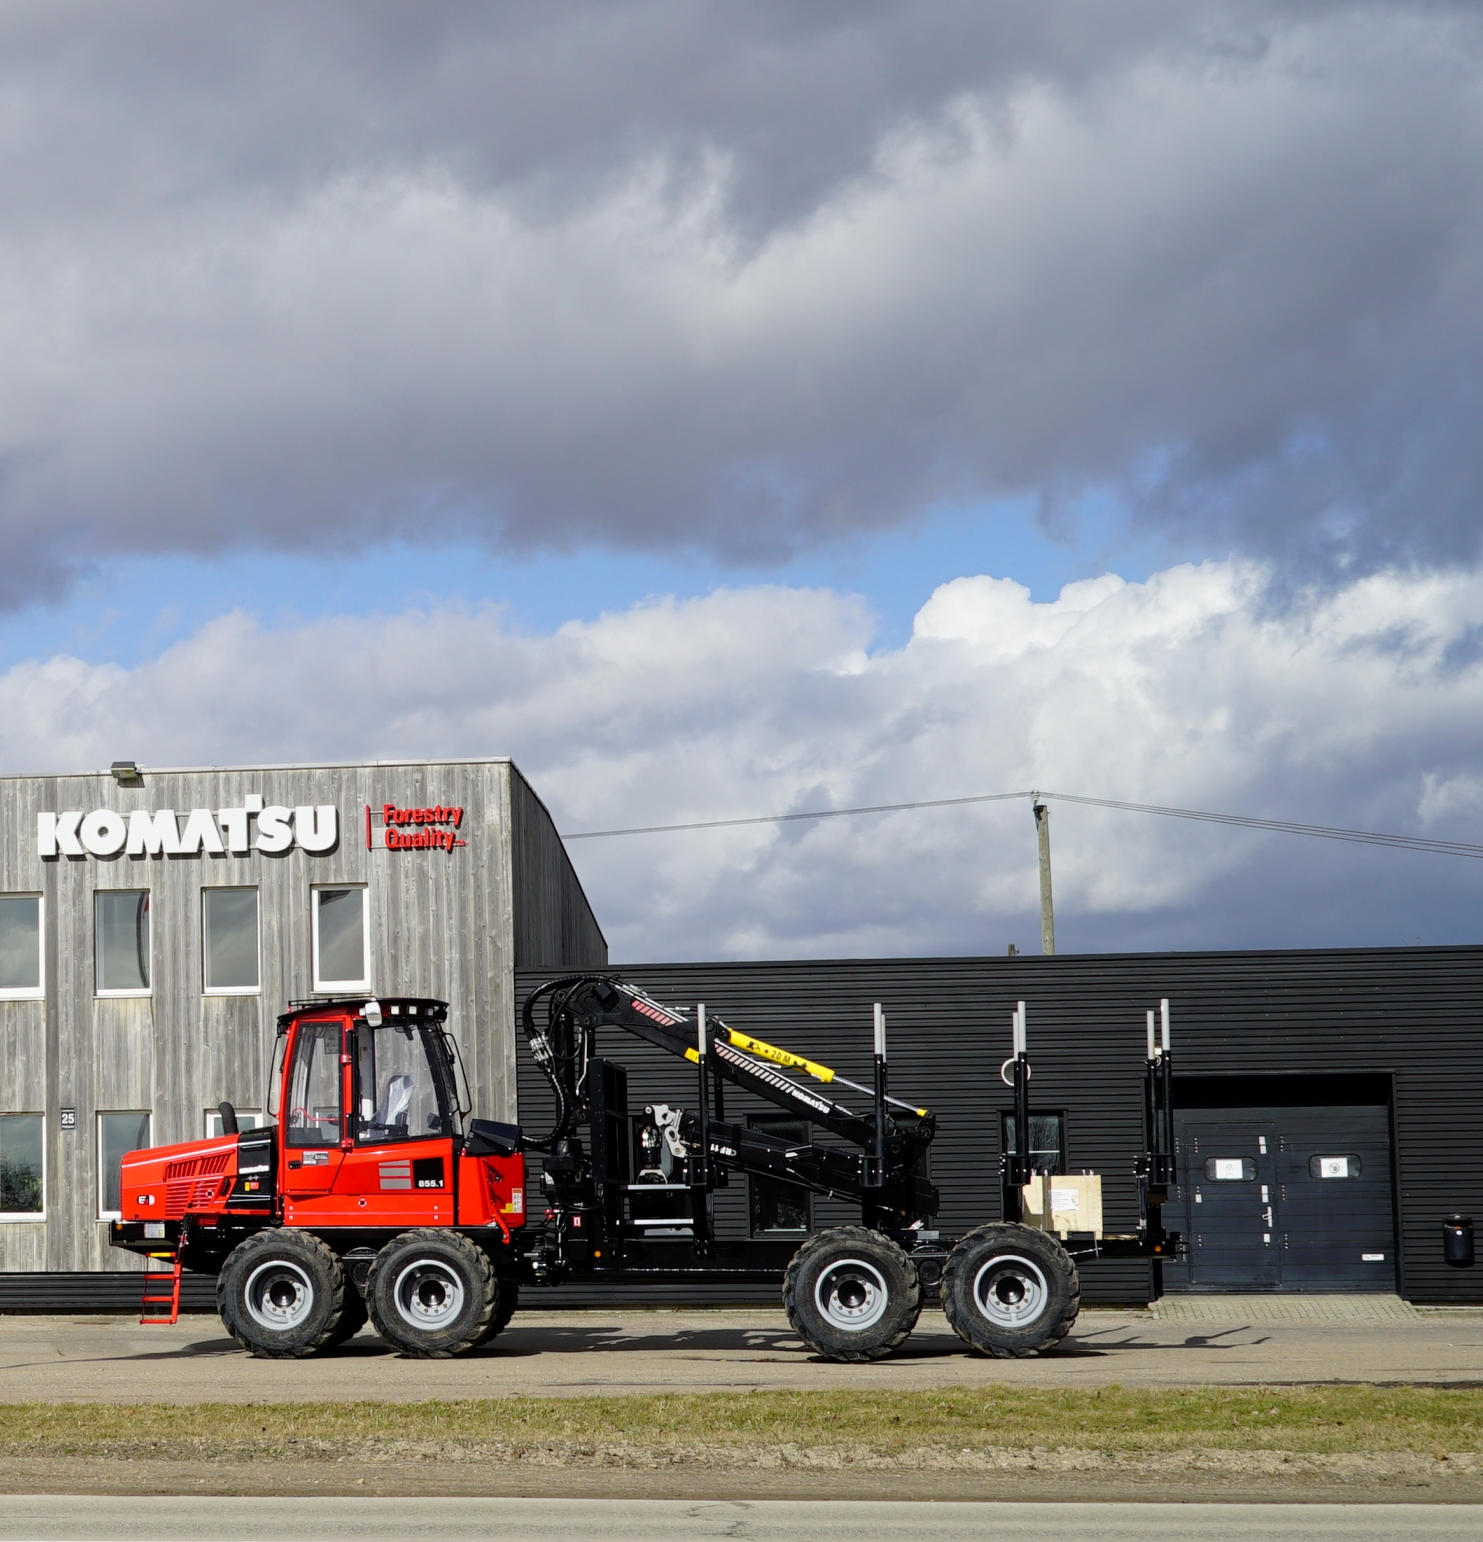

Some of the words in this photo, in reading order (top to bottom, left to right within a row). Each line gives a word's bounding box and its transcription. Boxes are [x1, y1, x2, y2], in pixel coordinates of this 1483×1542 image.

[383, 804, 463, 827] Forestry
[37, 794, 338, 856] KOMATSU
[770, 1049, 782, 1061] 20
[790, 1088, 831, 1115] KOMATSU
[61, 1112, 75, 1125] 25
[418, 1179, 444, 1188] 855.1
